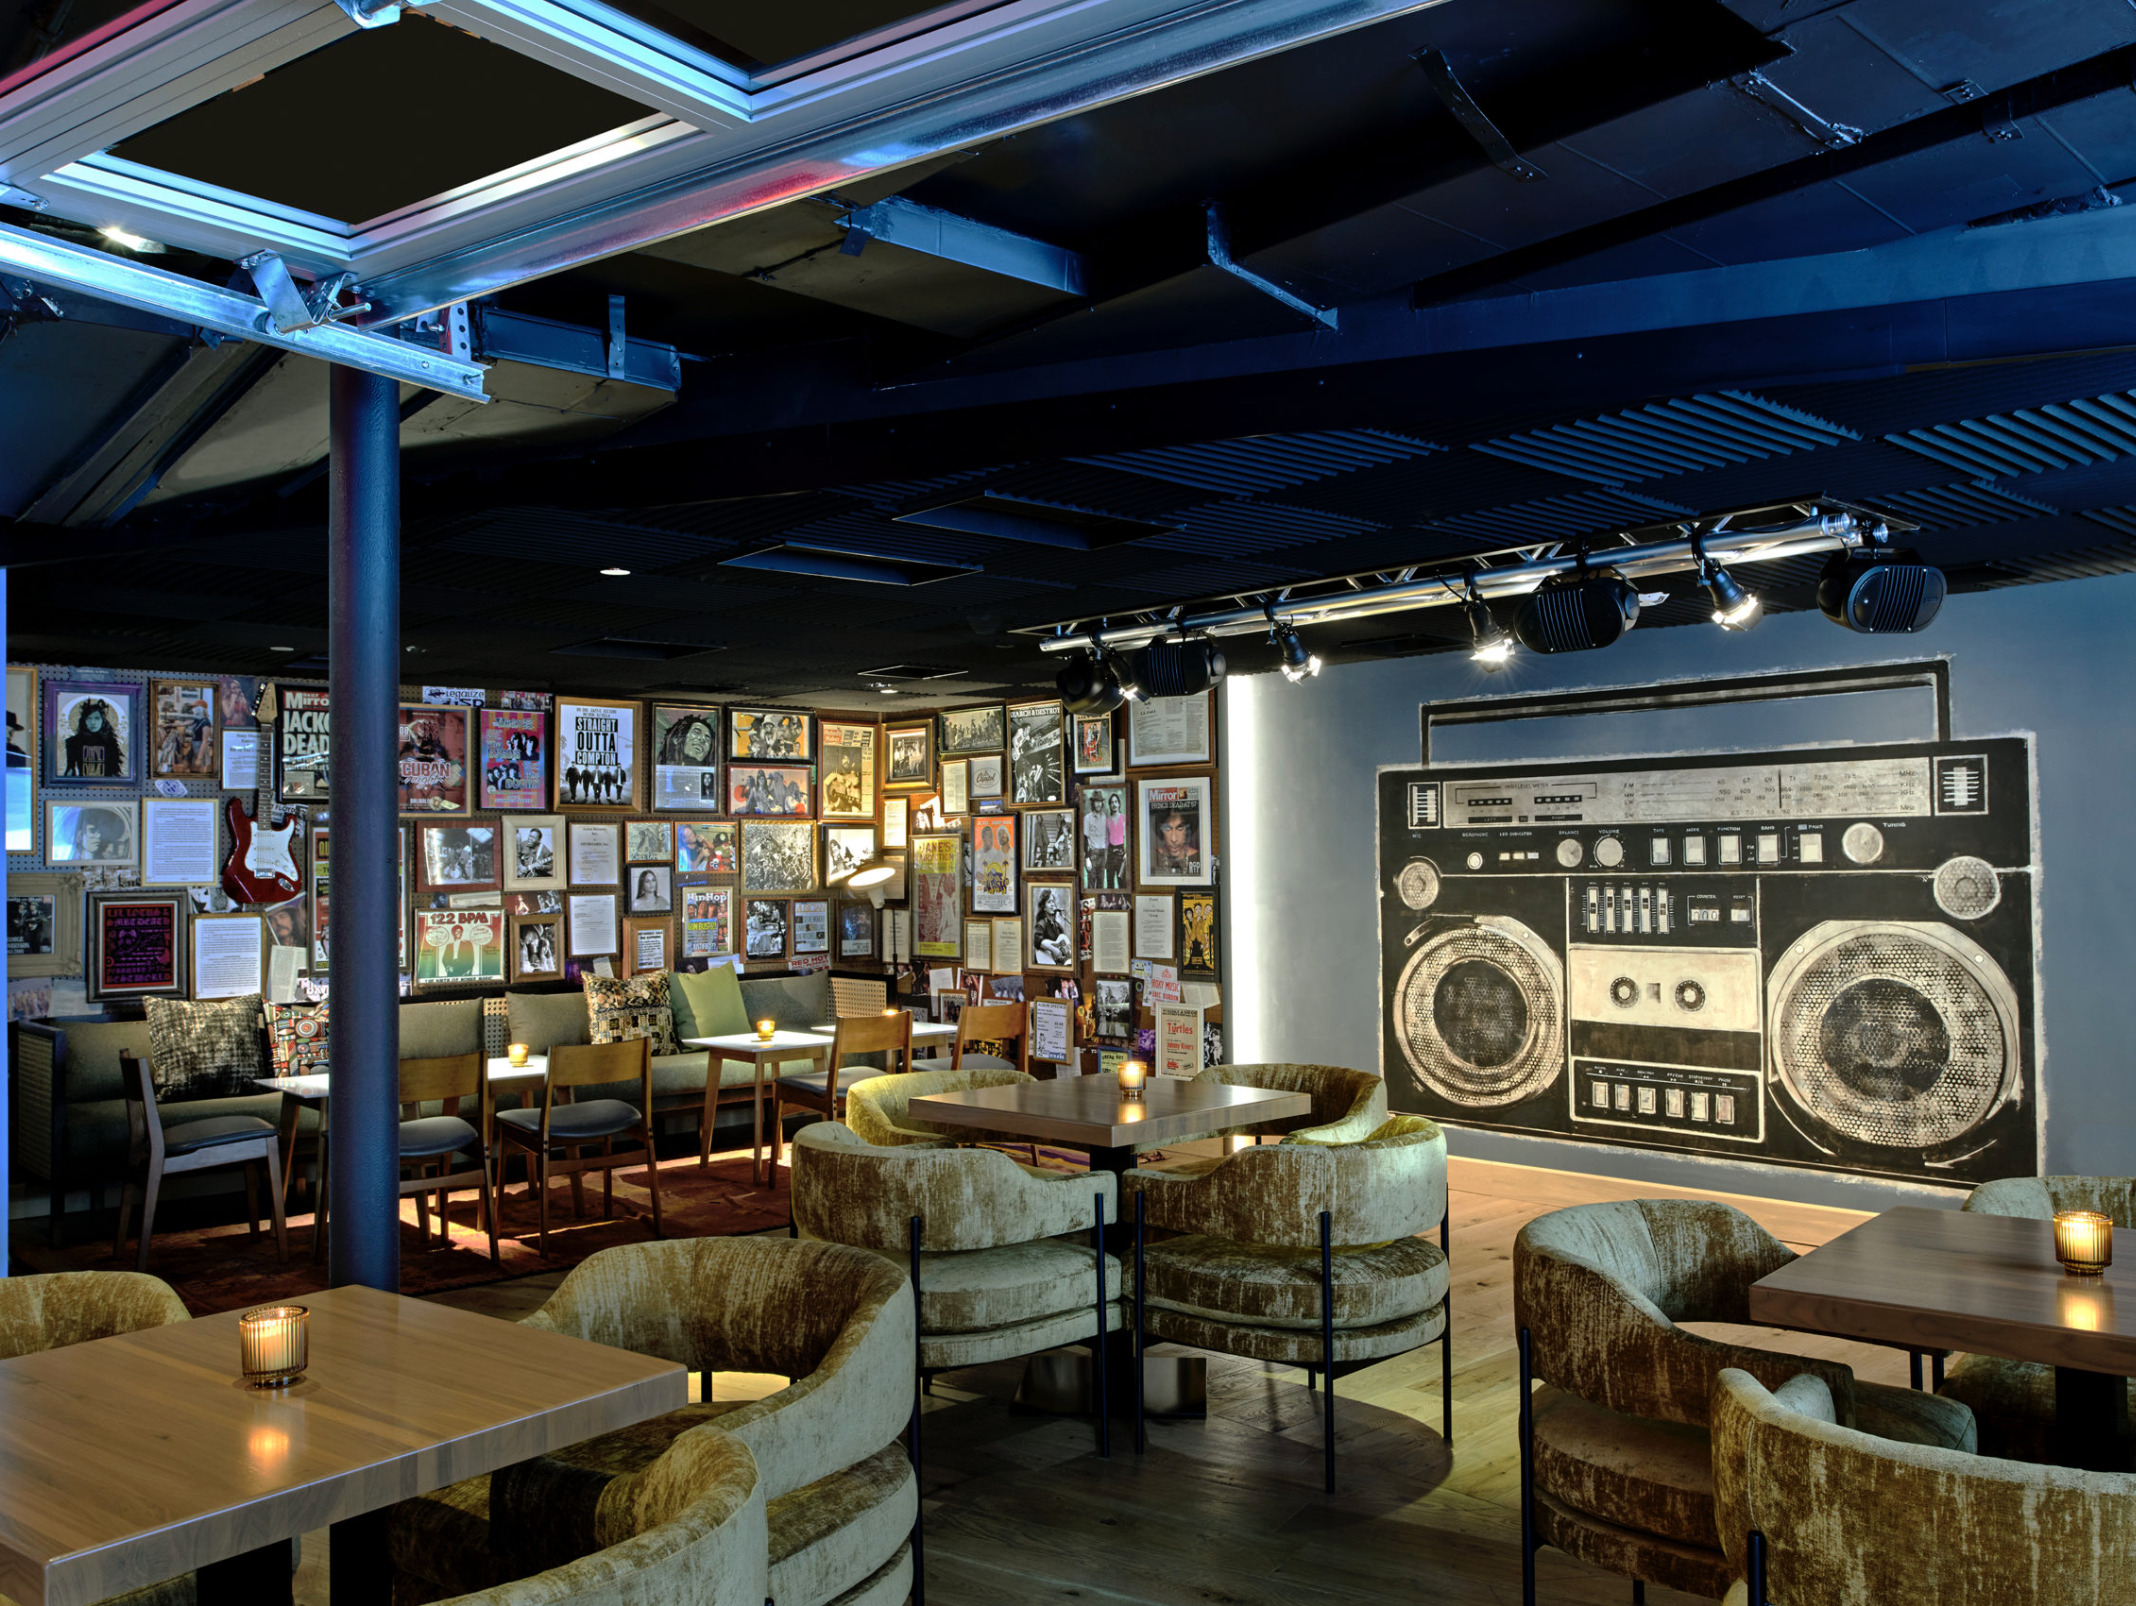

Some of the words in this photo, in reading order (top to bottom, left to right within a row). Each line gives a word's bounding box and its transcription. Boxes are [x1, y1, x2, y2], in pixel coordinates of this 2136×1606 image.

[285, 692, 330, 709] Mirro
[577, 717, 616, 732] STRAIGHT
[577, 732, 616, 751] OUTTA
[576, 752, 616, 766] COMPTON
[402, 761, 451, 778] CUBAN
[1150, 789, 1178, 801] Mirror
[430, 912, 456, 925] 122
[458, 912, 489, 924] BPM
[791, 958, 809, 966] RED
[811, 954, 829, 963] HOT
[1167, 1022, 1194, 1035] Turtles
